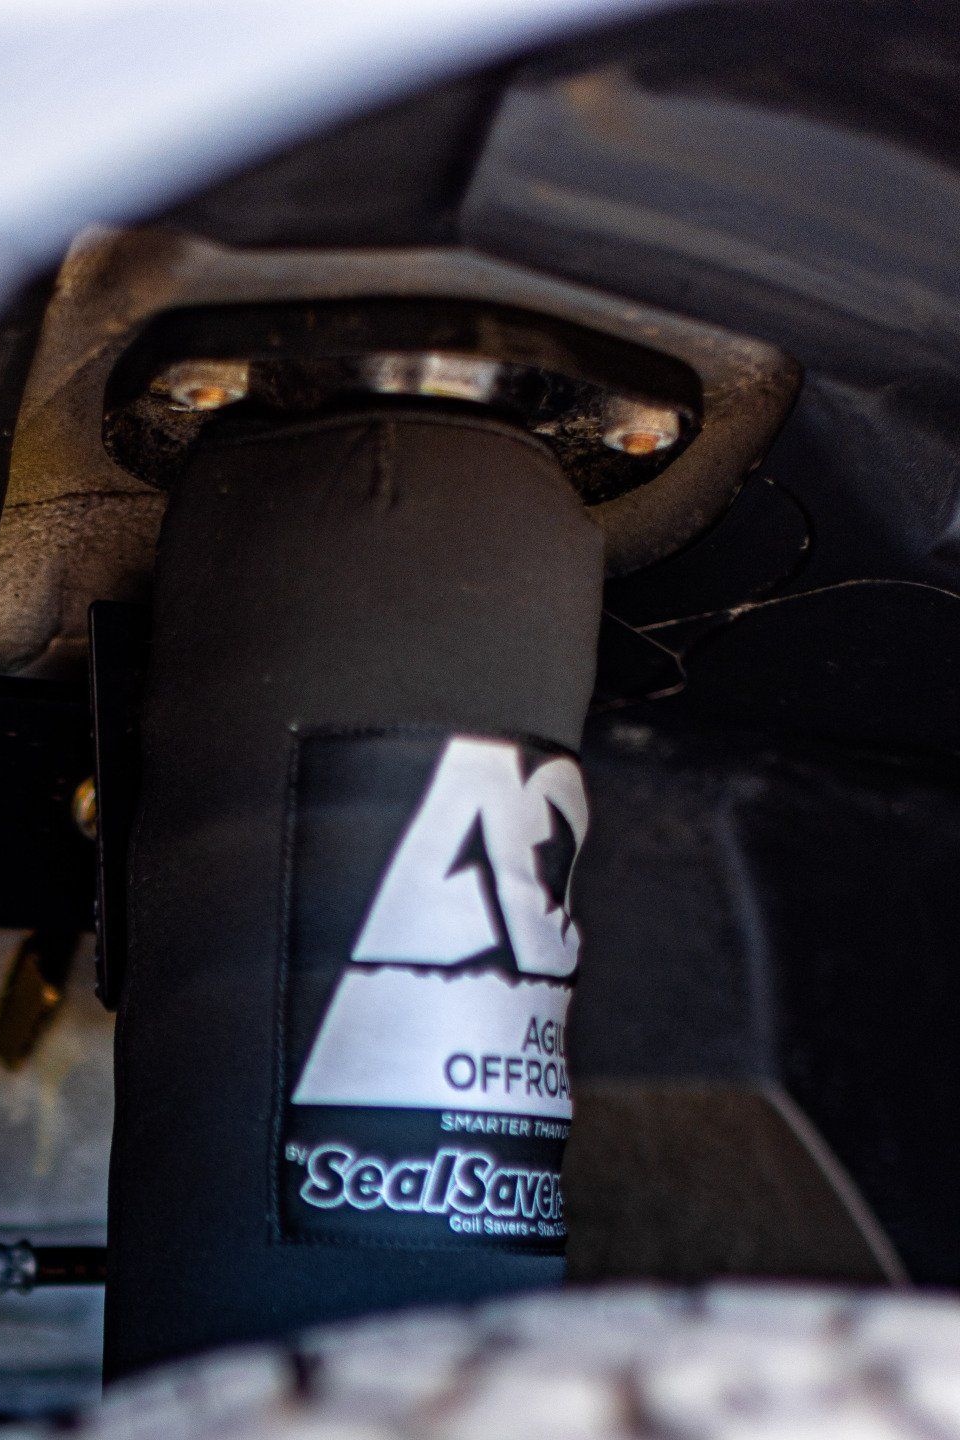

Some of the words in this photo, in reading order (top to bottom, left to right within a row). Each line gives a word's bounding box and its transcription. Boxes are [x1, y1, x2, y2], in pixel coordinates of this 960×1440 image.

[441, 1112, 531, 1137] SMARTER
[449, 1214, 480, 1234] Coil
[483, 1216, 528, 1237] Savers
